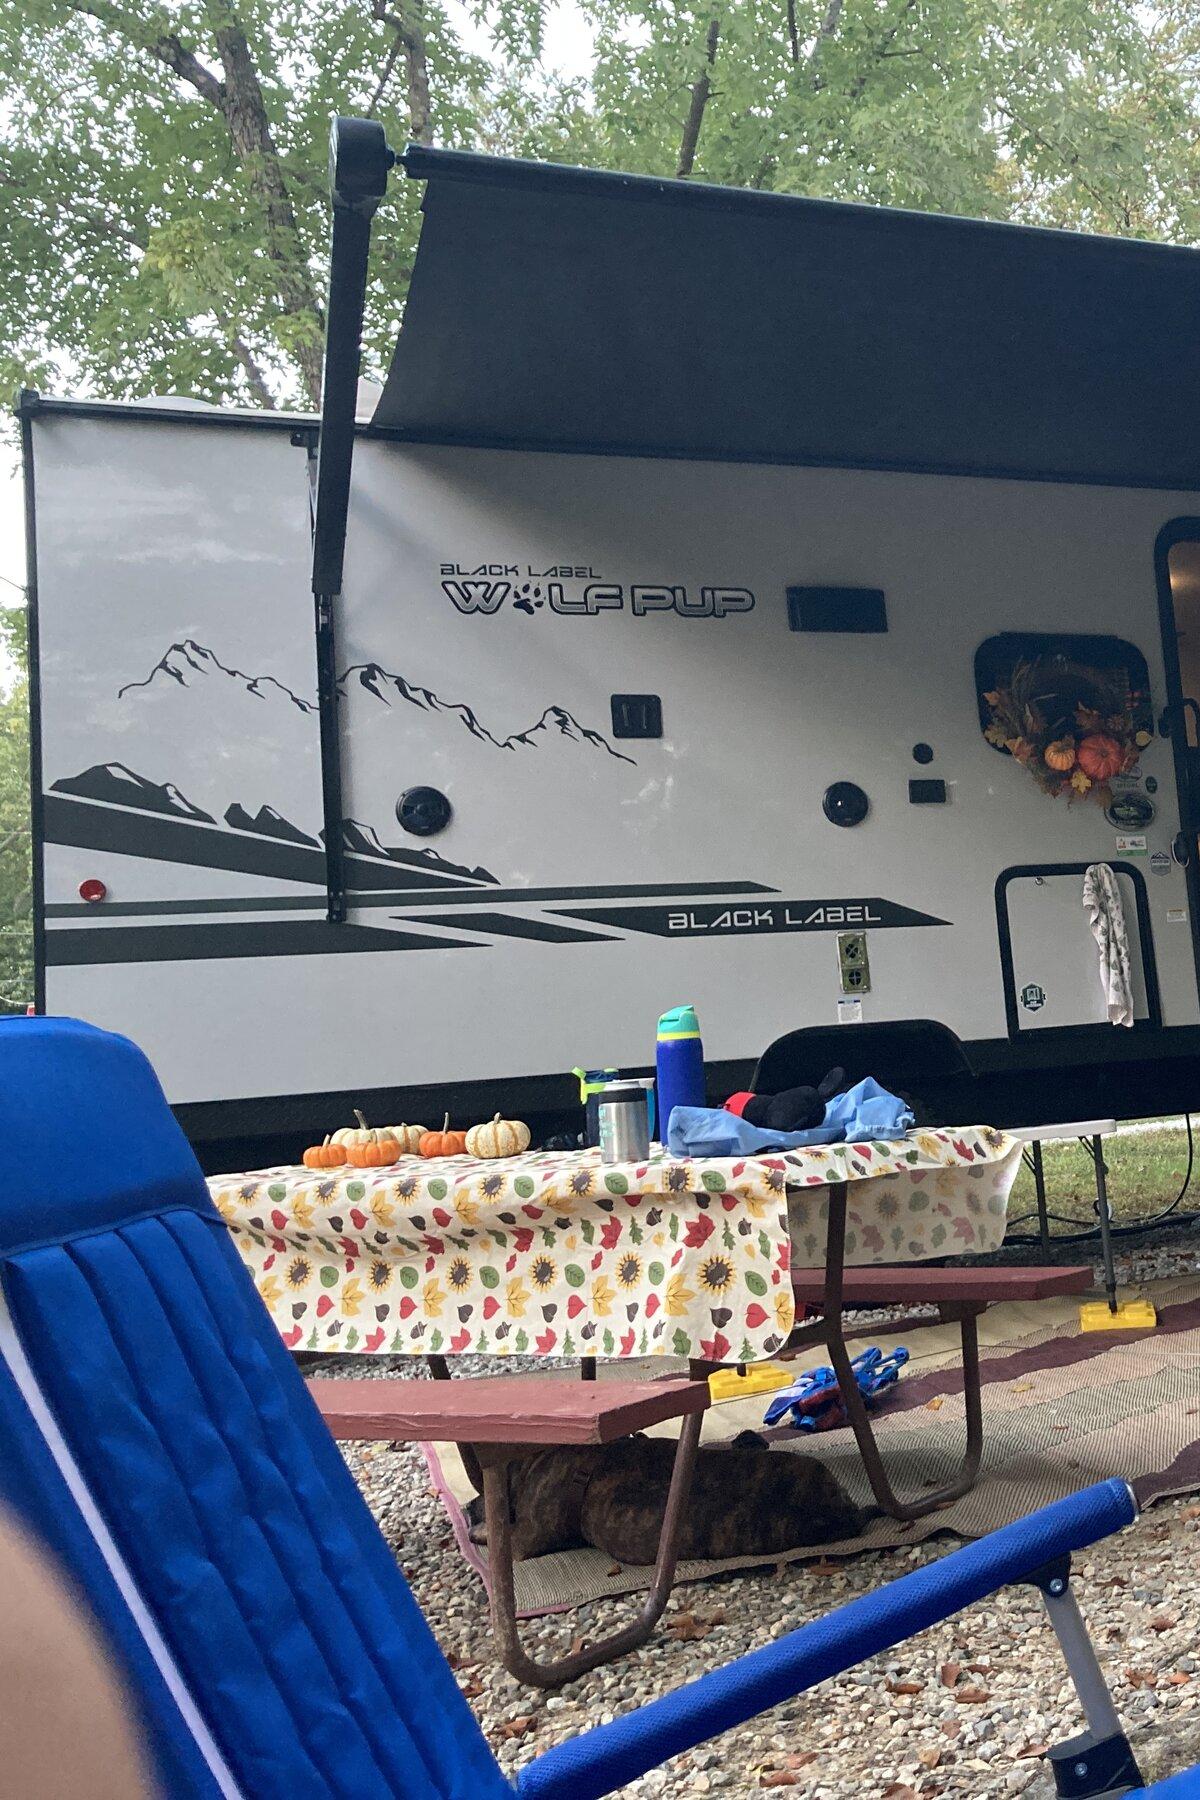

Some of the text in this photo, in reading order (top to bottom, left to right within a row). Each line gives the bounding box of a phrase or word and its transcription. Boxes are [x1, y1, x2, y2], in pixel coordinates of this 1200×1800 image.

[440, 564, 602, 579] BLACK LABEL
[441, 580, 755, 618] WLF PUP
[668, 905, 882, 929] BLACK LABEL
